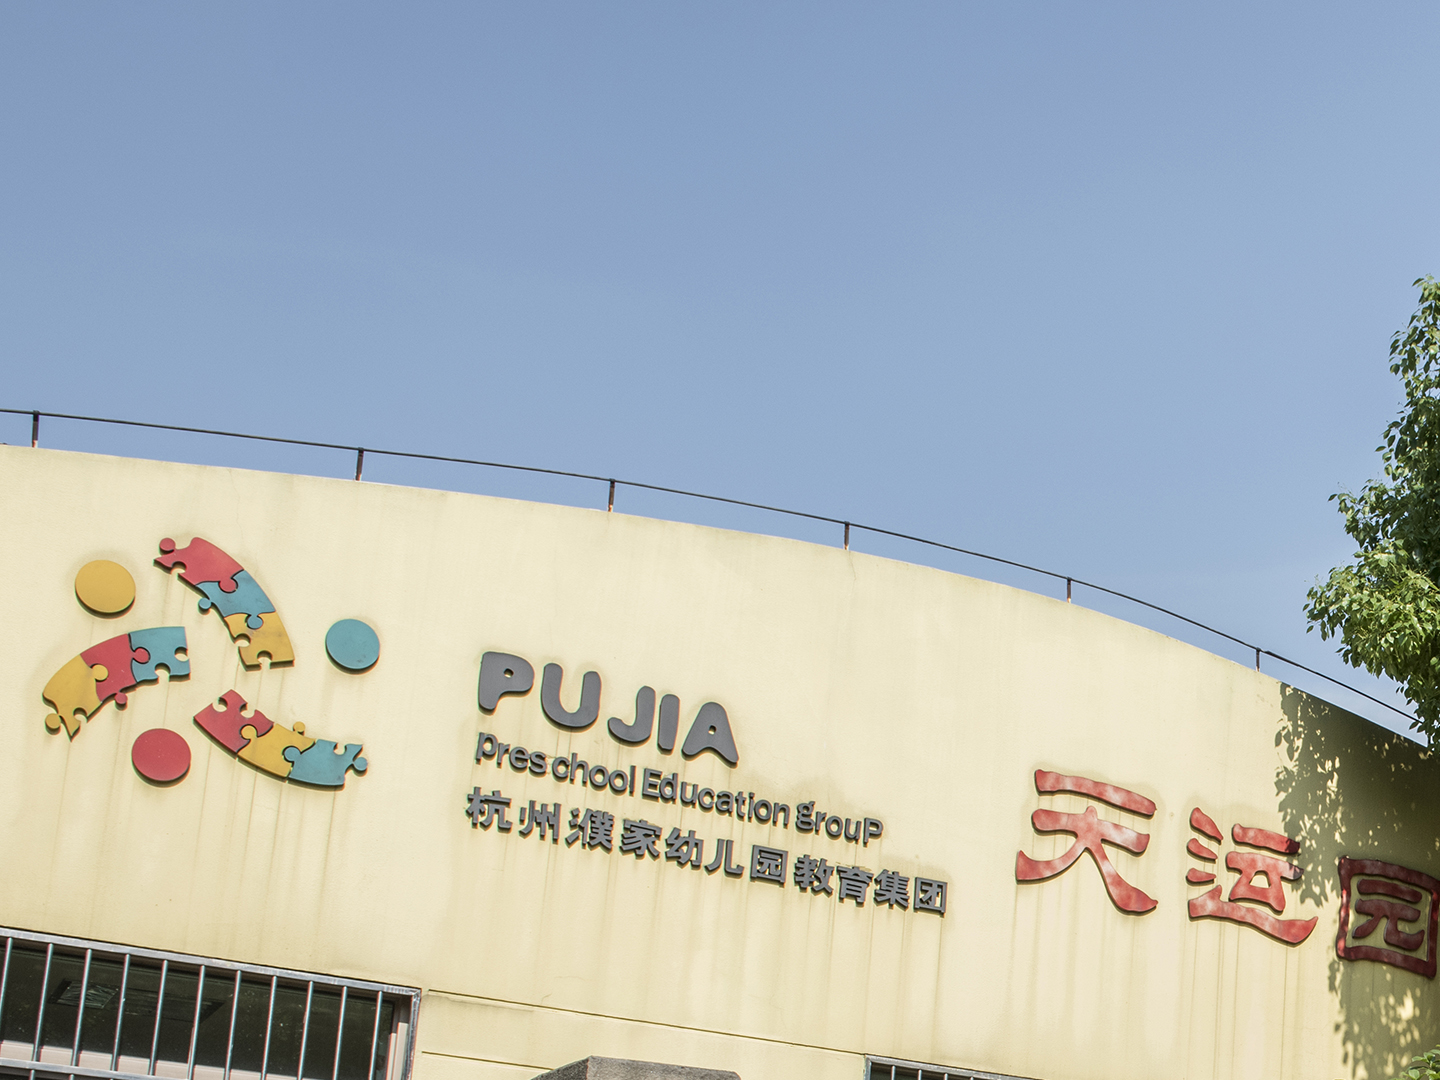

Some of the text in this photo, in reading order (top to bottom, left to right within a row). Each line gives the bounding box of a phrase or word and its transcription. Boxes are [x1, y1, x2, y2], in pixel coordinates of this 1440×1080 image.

[477, 651, 739, 764] PUJIA
[466, 786, 948, 915] 杭州濮家幼儿园教育集团
[642, 768, 790, 826] Education
